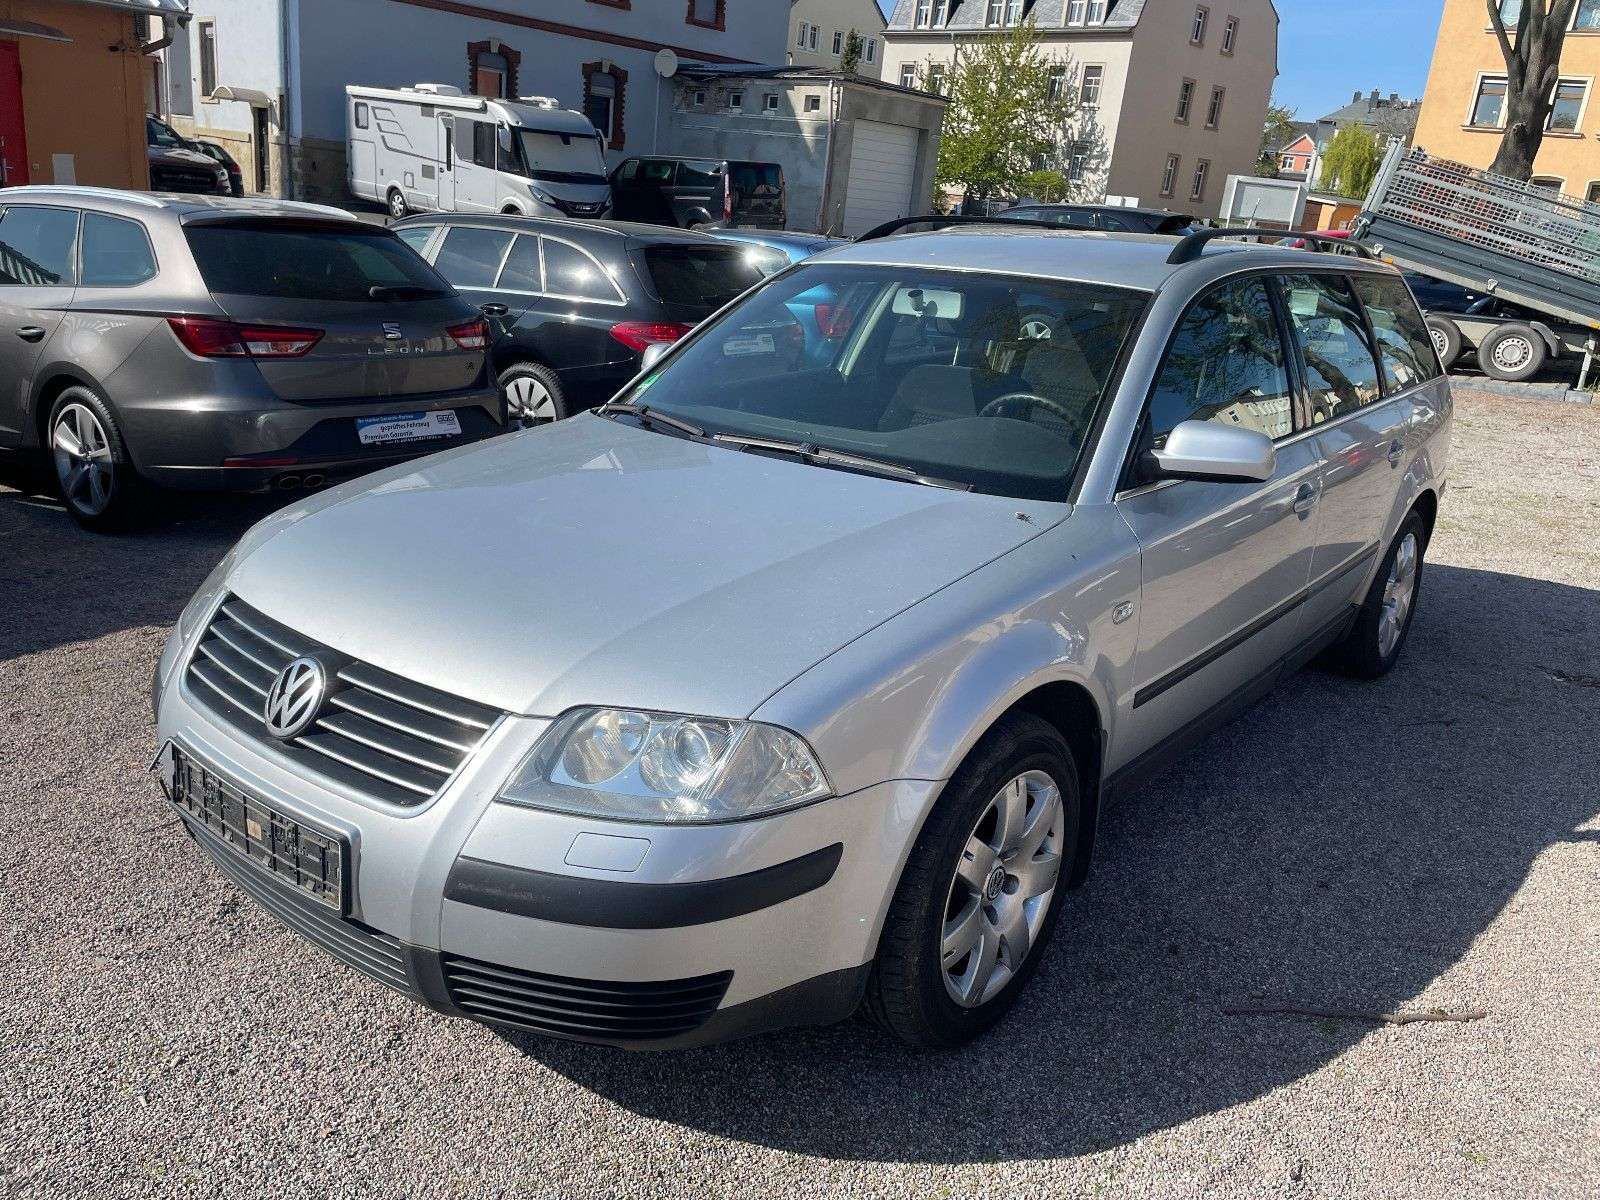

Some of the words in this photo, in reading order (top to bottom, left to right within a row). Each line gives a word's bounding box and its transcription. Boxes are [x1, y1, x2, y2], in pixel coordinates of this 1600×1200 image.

[367, 347, 424, 355] LEON
[407, 421, 430, 430] Fahrzeug
[364, 433, 389, 441] Premium
[389, 430, 413, 438] Garantie
[265, 656, 325, 738] VW
